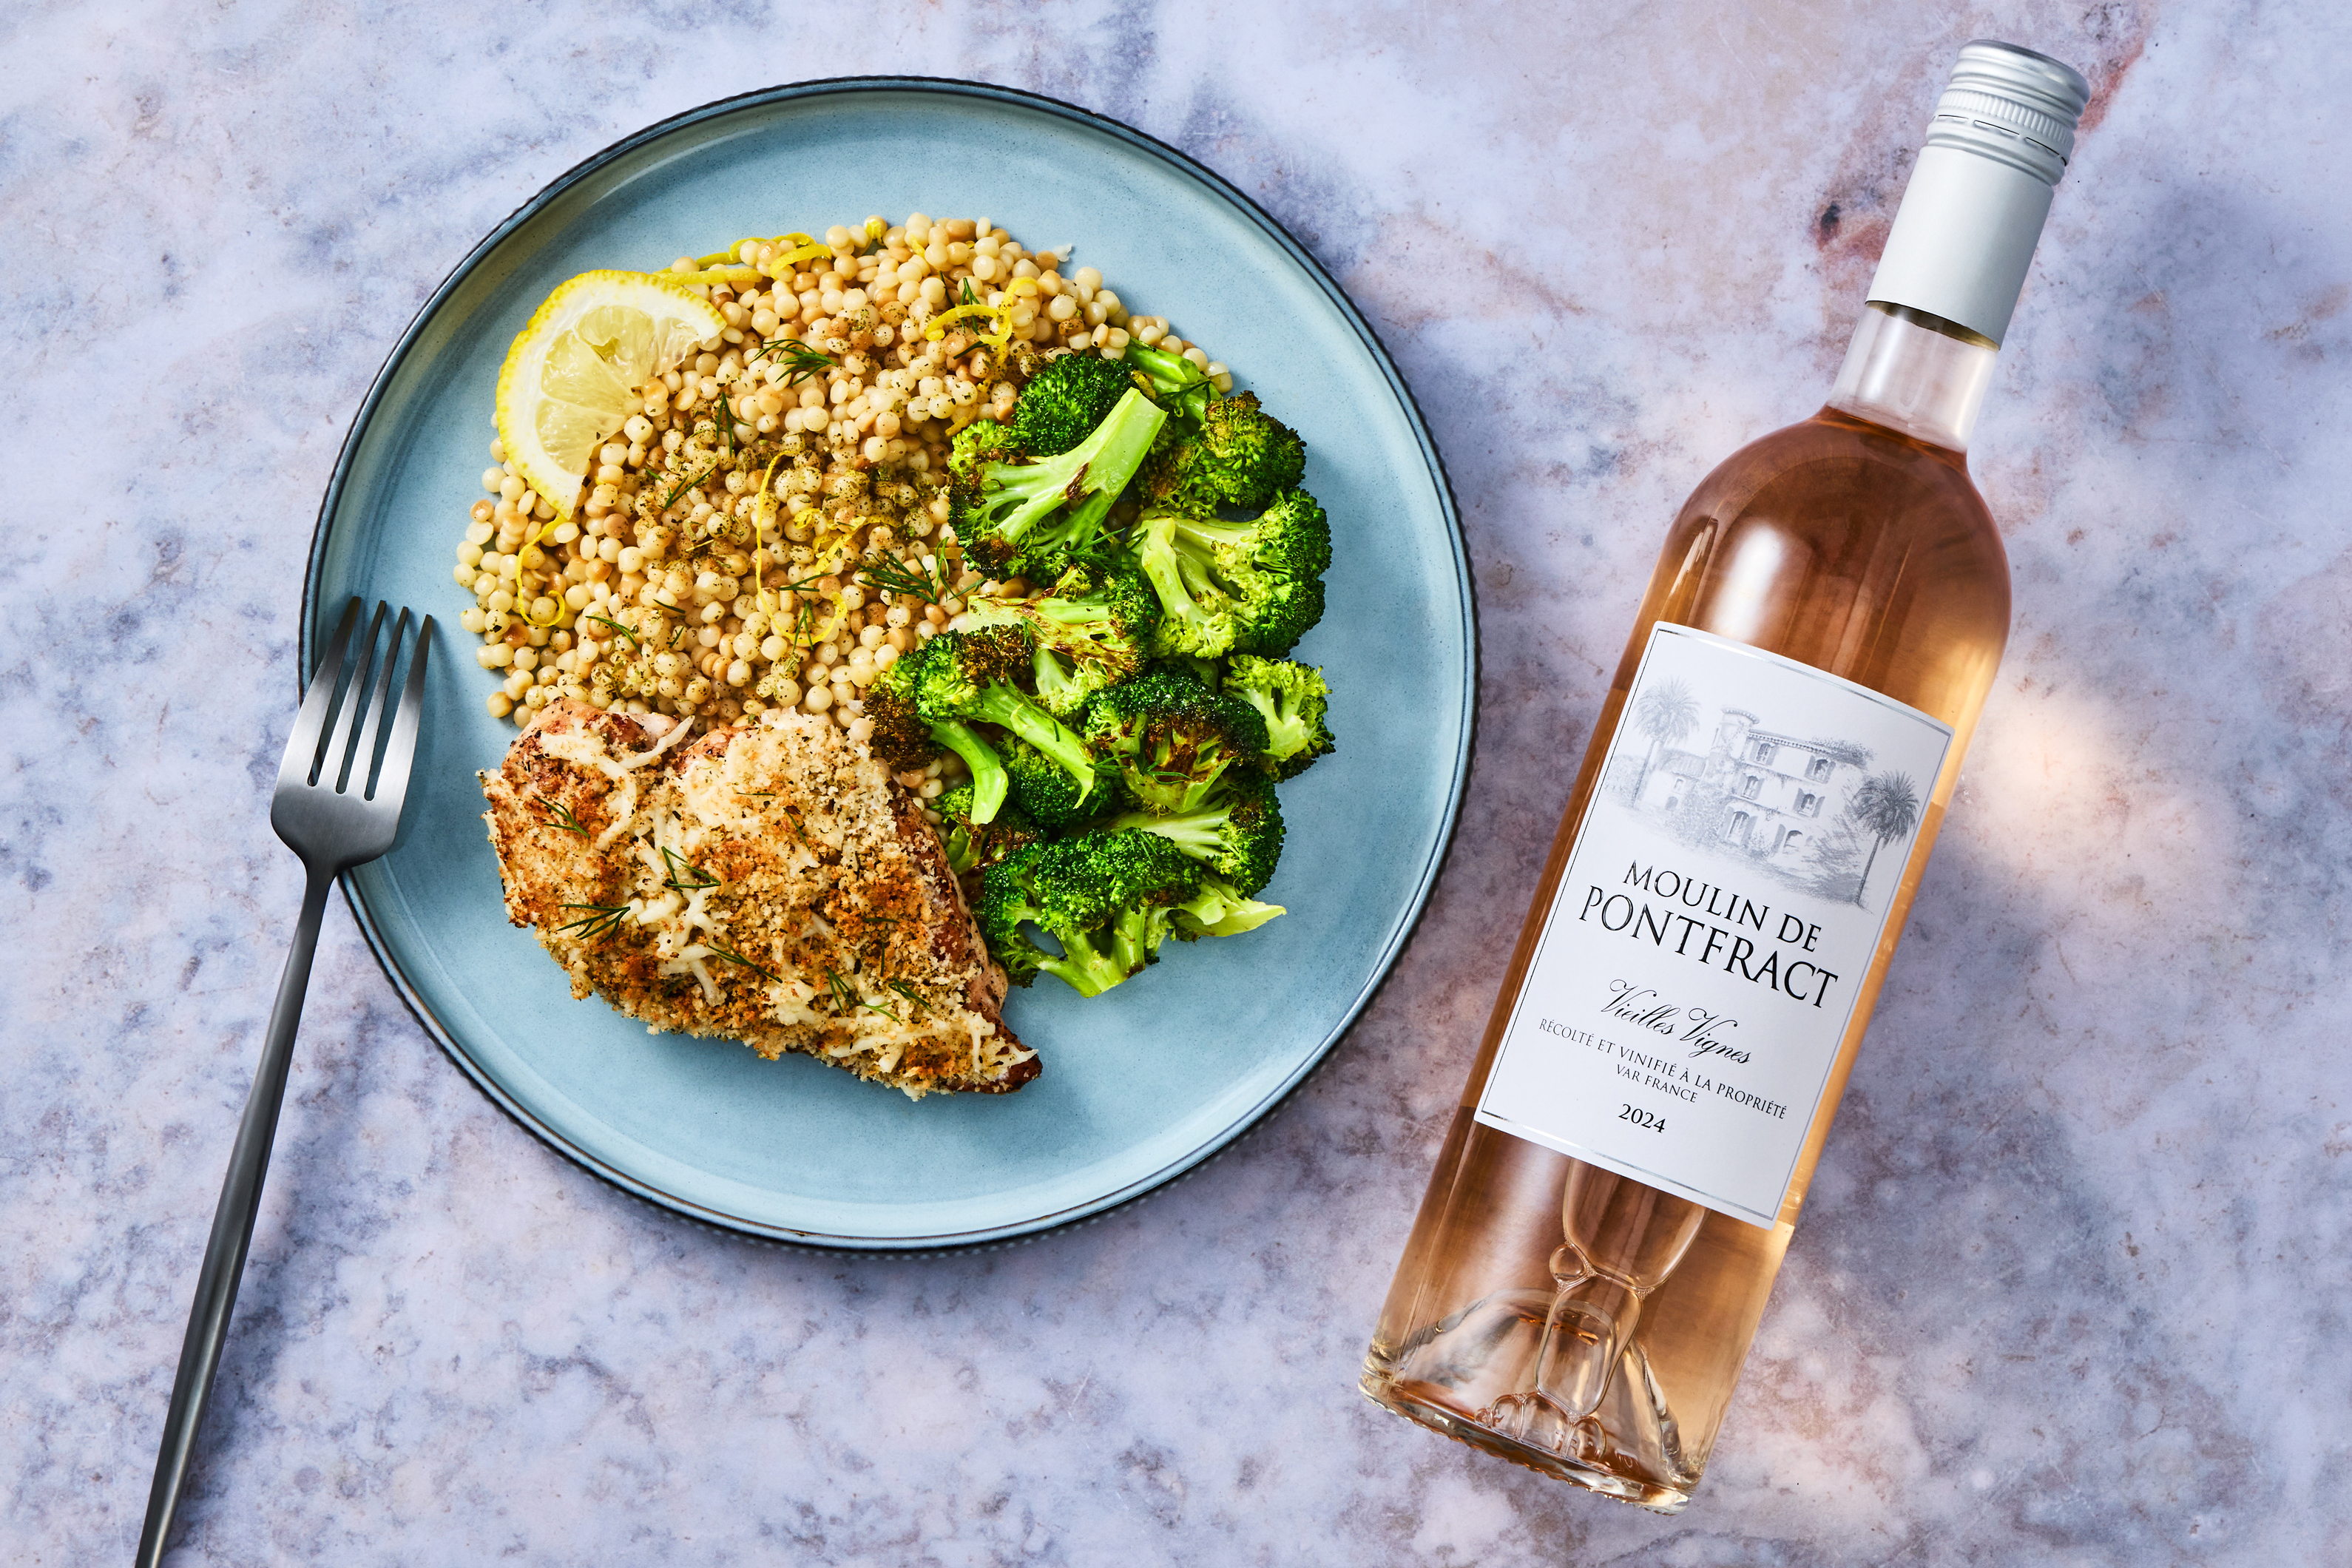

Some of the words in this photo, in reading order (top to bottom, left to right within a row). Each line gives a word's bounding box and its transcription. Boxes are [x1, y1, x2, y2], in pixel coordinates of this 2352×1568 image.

[1578, 885, 1839, 1009] PONTFRACT
[1621, 859, 1771, 932] MOULIN
[1775, 913, 1822, 953] DE
[1600, 979, 1681, 1035] Vieilles
[1678, 1007, 1751, 1064] Vignes
[1538, 1018, 1595, 1047] RÉCOLTÉ
[1597, 1038, 1616, 1054] ET
[1620, 1045, 1677, 1078] VINIFIÉ
[1678, 1067, 1689, 1084] À
[1694, 1074, 1711, 1092] LA
[1716, 1082, 1788, 1120] PROPRIÉTÉ
[1617, 1064, 1640, 1083] VAR
[1644, 1075, 1698, 1104] FRANCE
[1618, 1103, 1666, 1134] 2024
